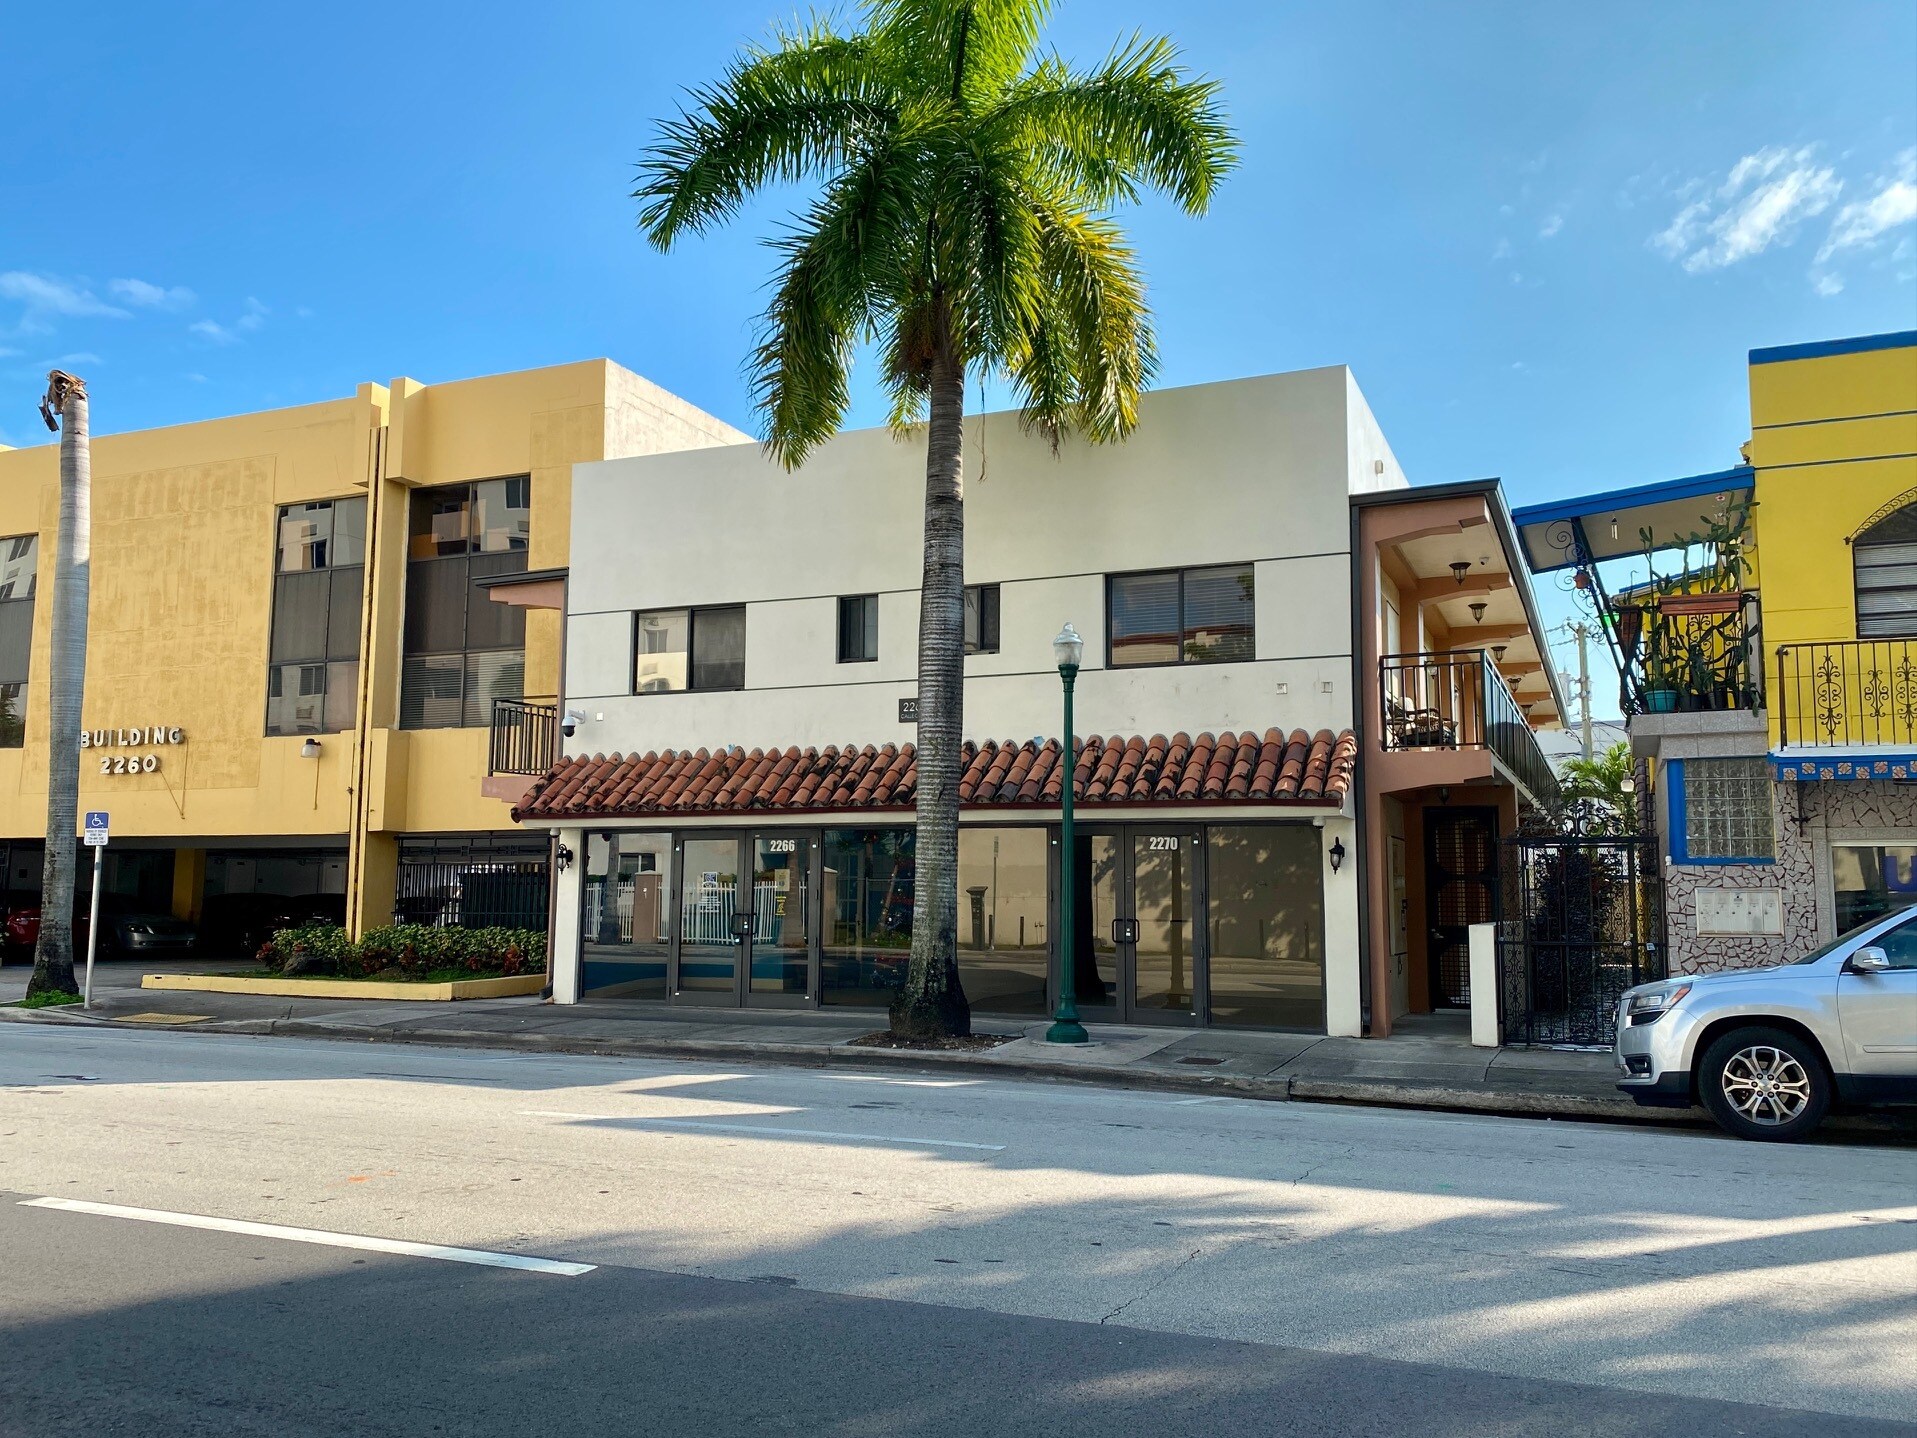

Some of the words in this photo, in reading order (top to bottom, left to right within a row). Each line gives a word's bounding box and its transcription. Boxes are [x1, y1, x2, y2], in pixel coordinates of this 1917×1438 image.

[80, 729, 181, 748] BUILDING
[100, 754, 157, 774] 2260
[770, 840, 796, 852] 2266
[1149, 836, 1178, 850] 2270
